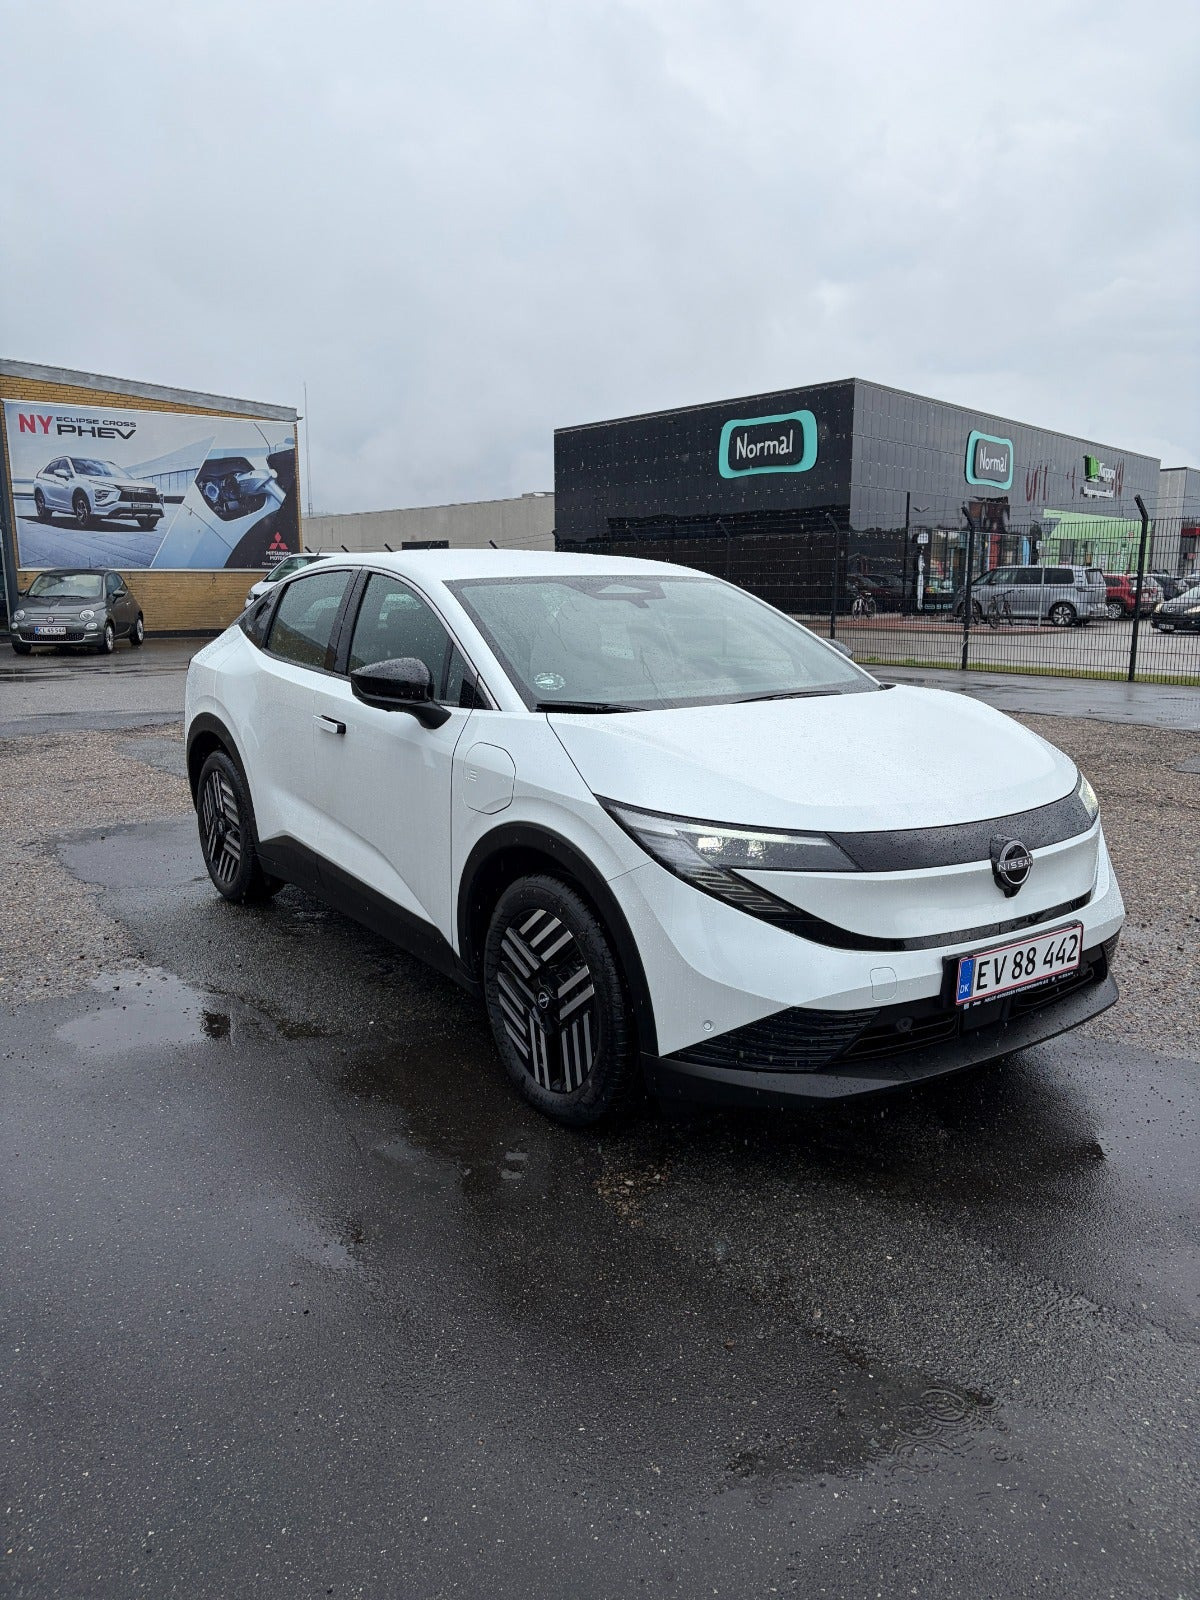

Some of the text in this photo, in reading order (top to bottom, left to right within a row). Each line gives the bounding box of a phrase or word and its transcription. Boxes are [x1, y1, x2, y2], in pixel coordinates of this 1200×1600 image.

[18, 413, 53, 434] NY
[56, 416, 137, 427] ECLIPSE CROSS
[56, 423, 137, 439] PHEV
[736, 429, 794, 460] Normal
[979, 446, 1008, 473] Normal
[998, 857, 1033, 871] NISSAN
[976, 934, 1079, 991] EV 88 442
[959, 983, 970, 994] DK
